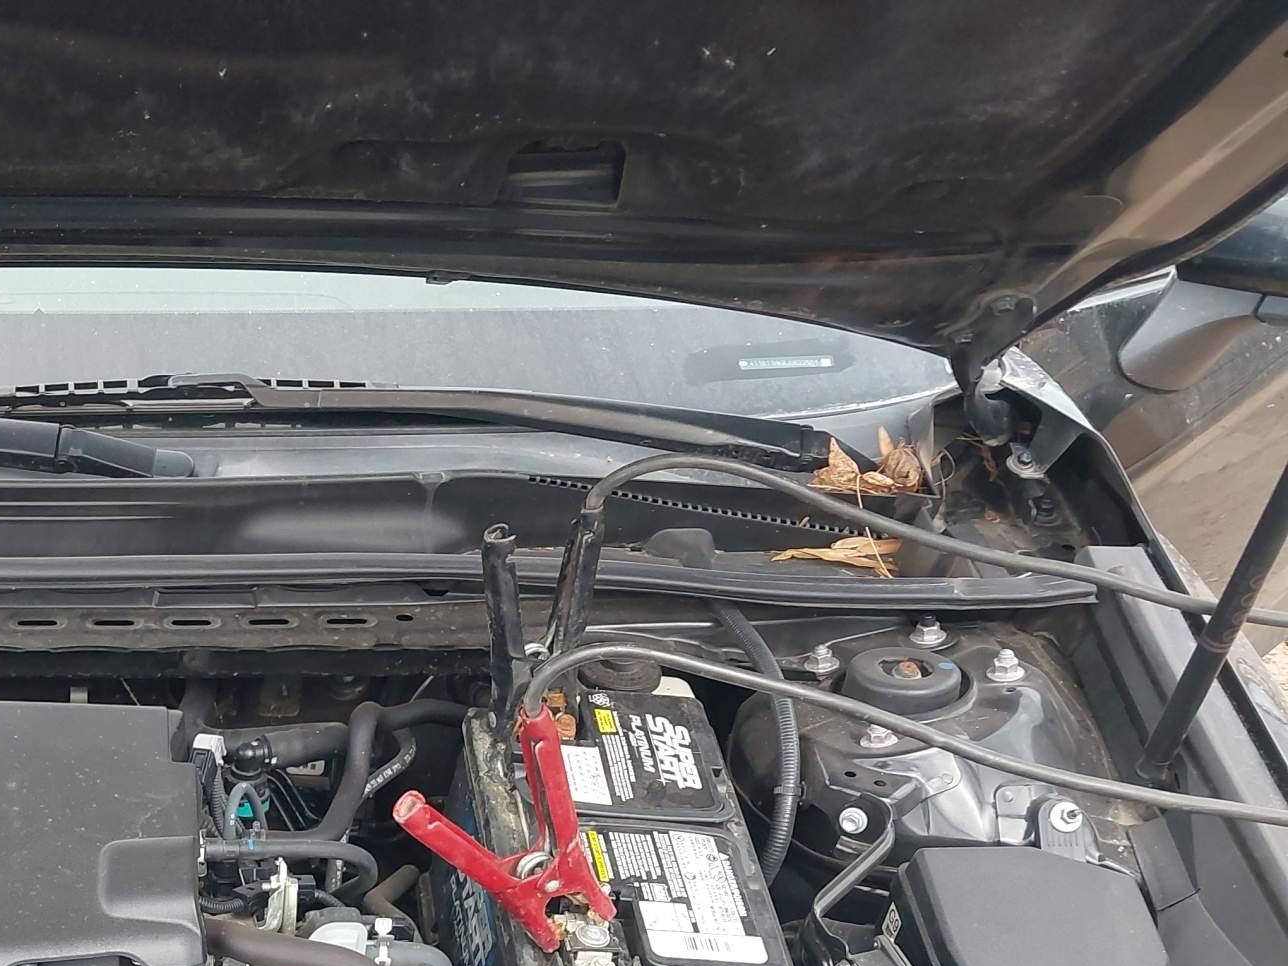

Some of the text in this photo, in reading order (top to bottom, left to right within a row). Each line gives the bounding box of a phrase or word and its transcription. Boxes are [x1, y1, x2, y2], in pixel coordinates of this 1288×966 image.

[629, 714, 656, 773] PLATINUM
[645, 714, 688, 790] START
[674, 725, 703, 790] SUPER
